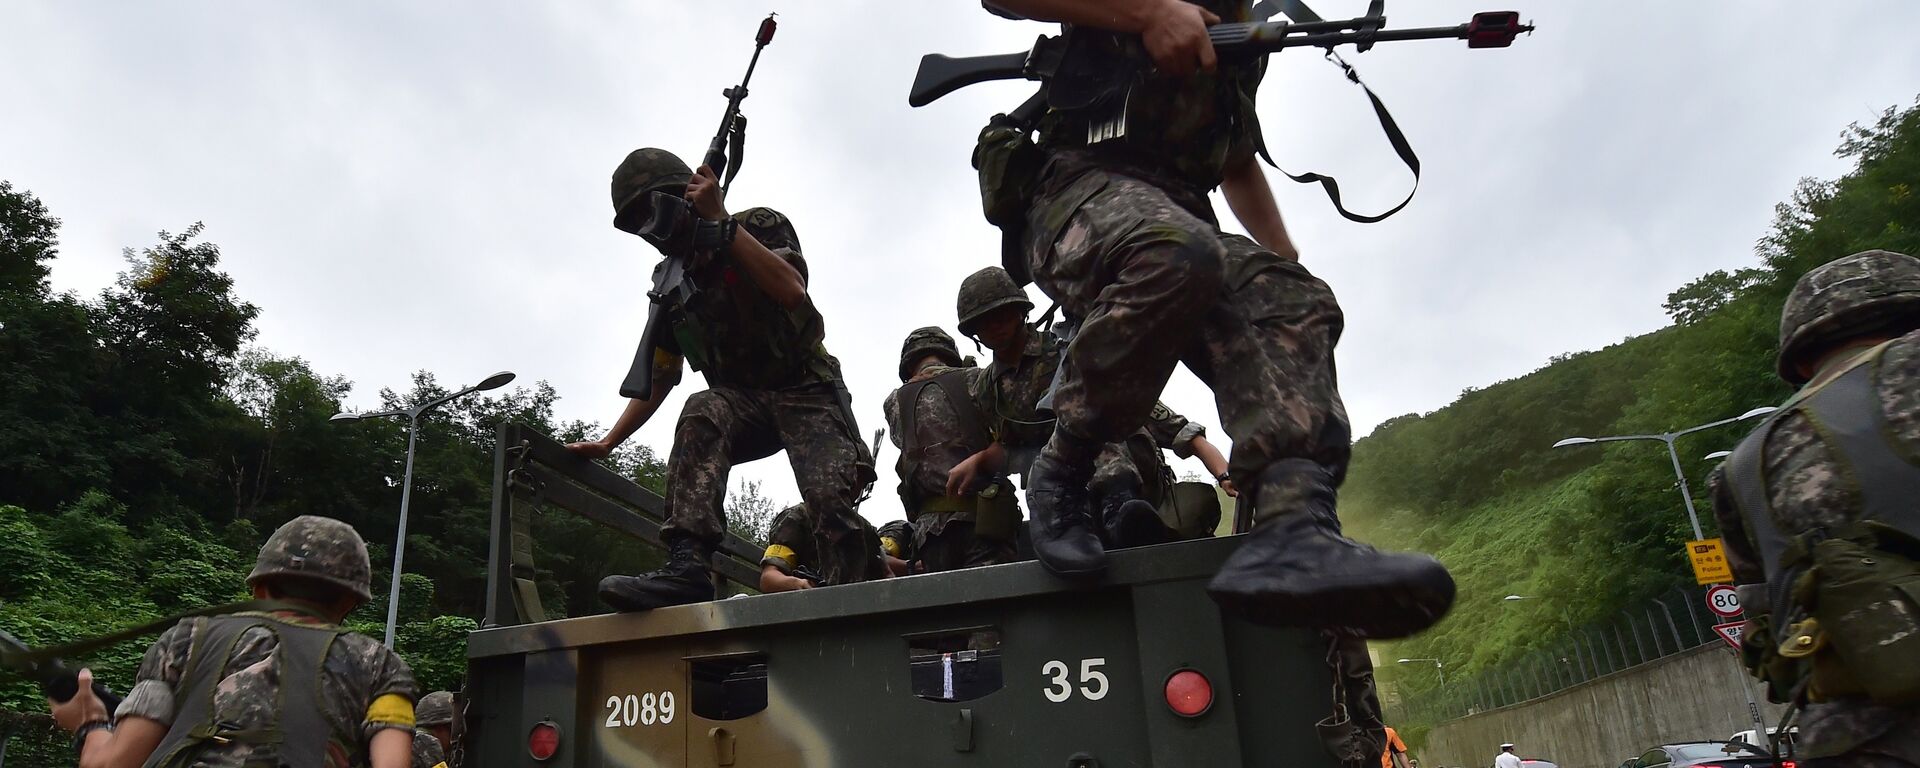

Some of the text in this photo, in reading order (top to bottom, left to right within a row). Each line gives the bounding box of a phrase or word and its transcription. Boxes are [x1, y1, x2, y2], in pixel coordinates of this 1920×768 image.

[1714, 593, 1739, 608] 80
[1042, 657, 1109, 703] 35
[605, 690, 675, 727] 2089
